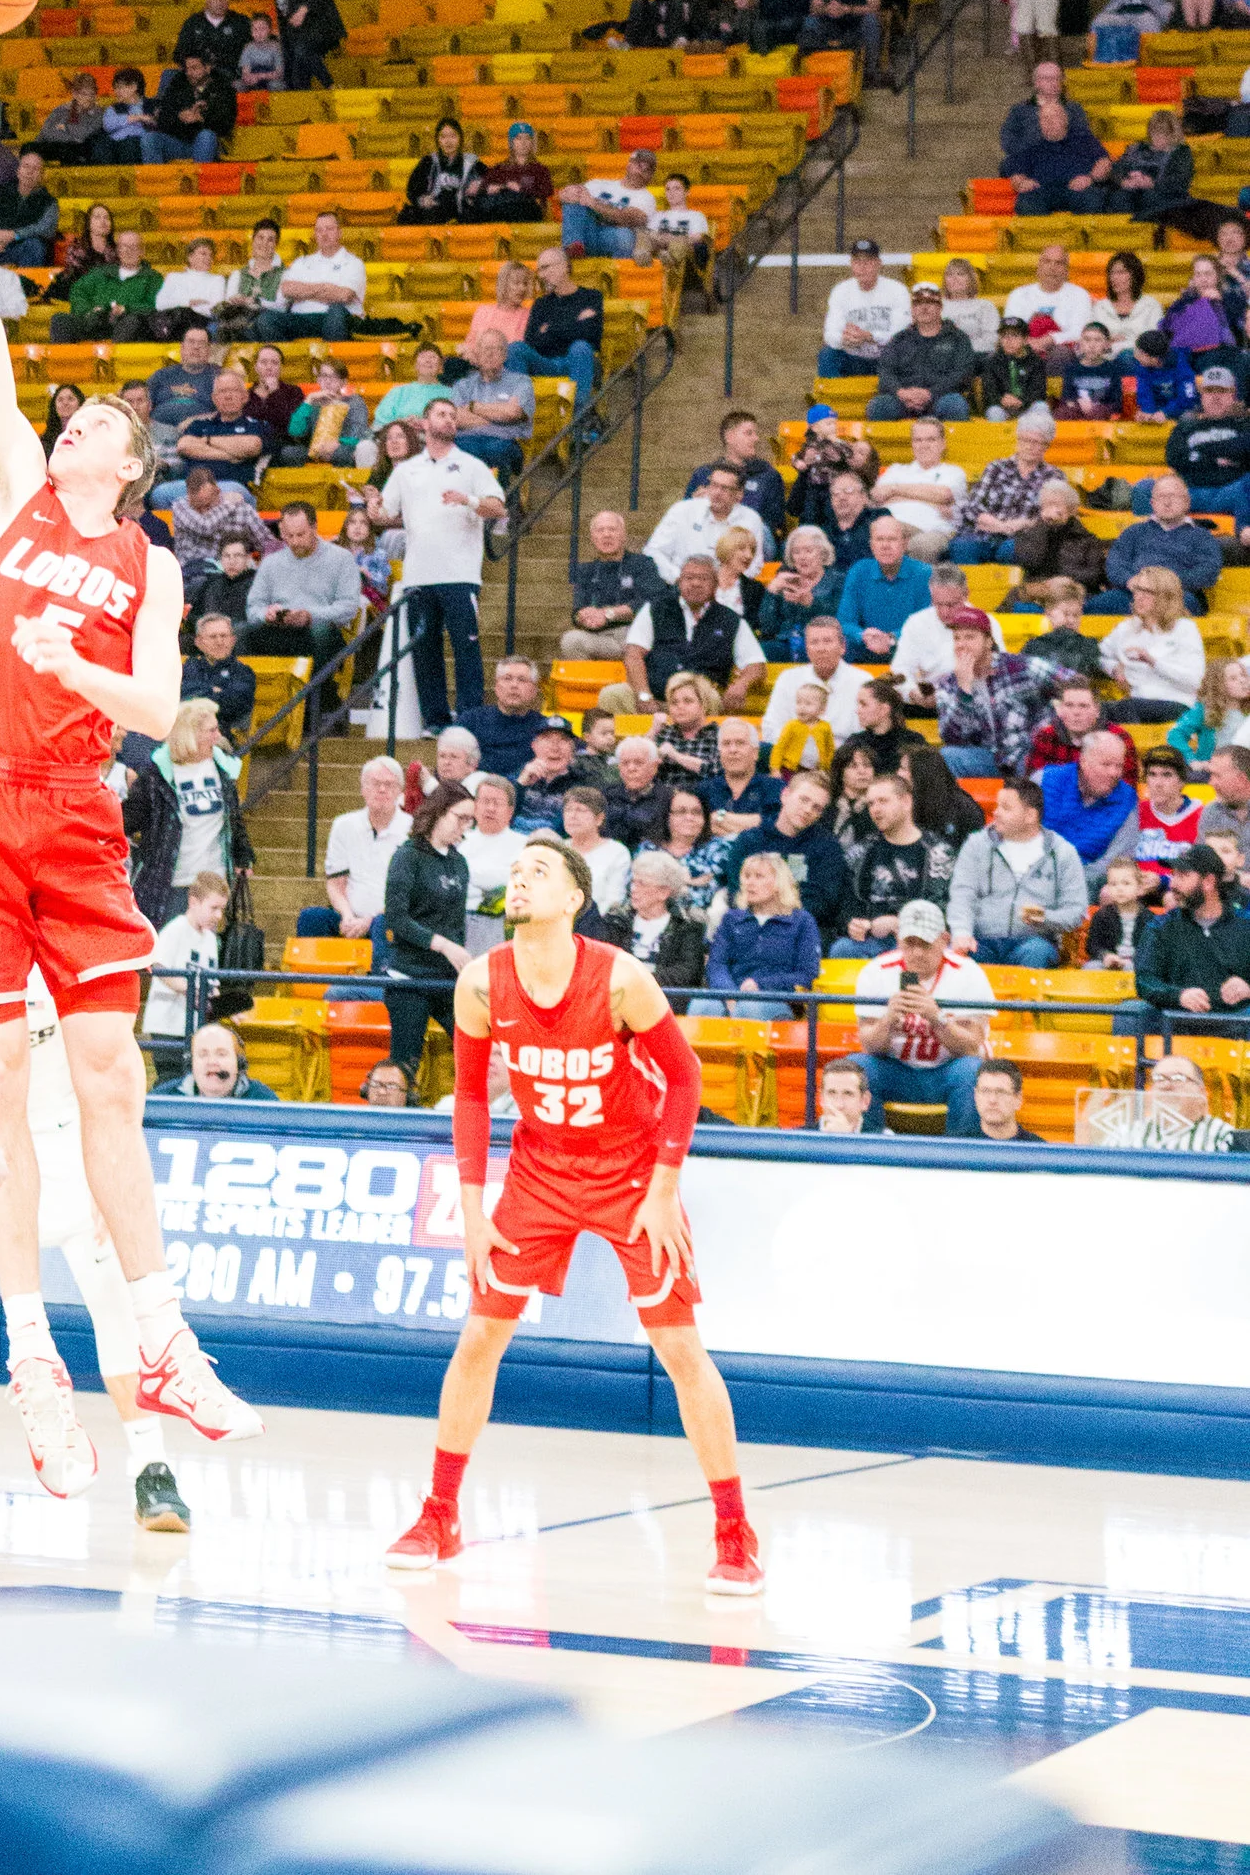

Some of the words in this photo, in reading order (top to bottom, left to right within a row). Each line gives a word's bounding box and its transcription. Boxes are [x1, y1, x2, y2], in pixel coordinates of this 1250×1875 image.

[0, 536, 137, 619] LOBOS
[500, 1040, 614, 1081] LOBOS
[533, 1081, 604, 1127] 32
[154, 1137, 422, 1215] 1280
[203, 1202, 308, 1239] SPORTS
[311, 1210, 415, 1246] LEADER
[161, 1240, 242, 1304] 280
[247, 1247, 317, 1308] AM
[372, 1254, 472, 1320] 97.5
